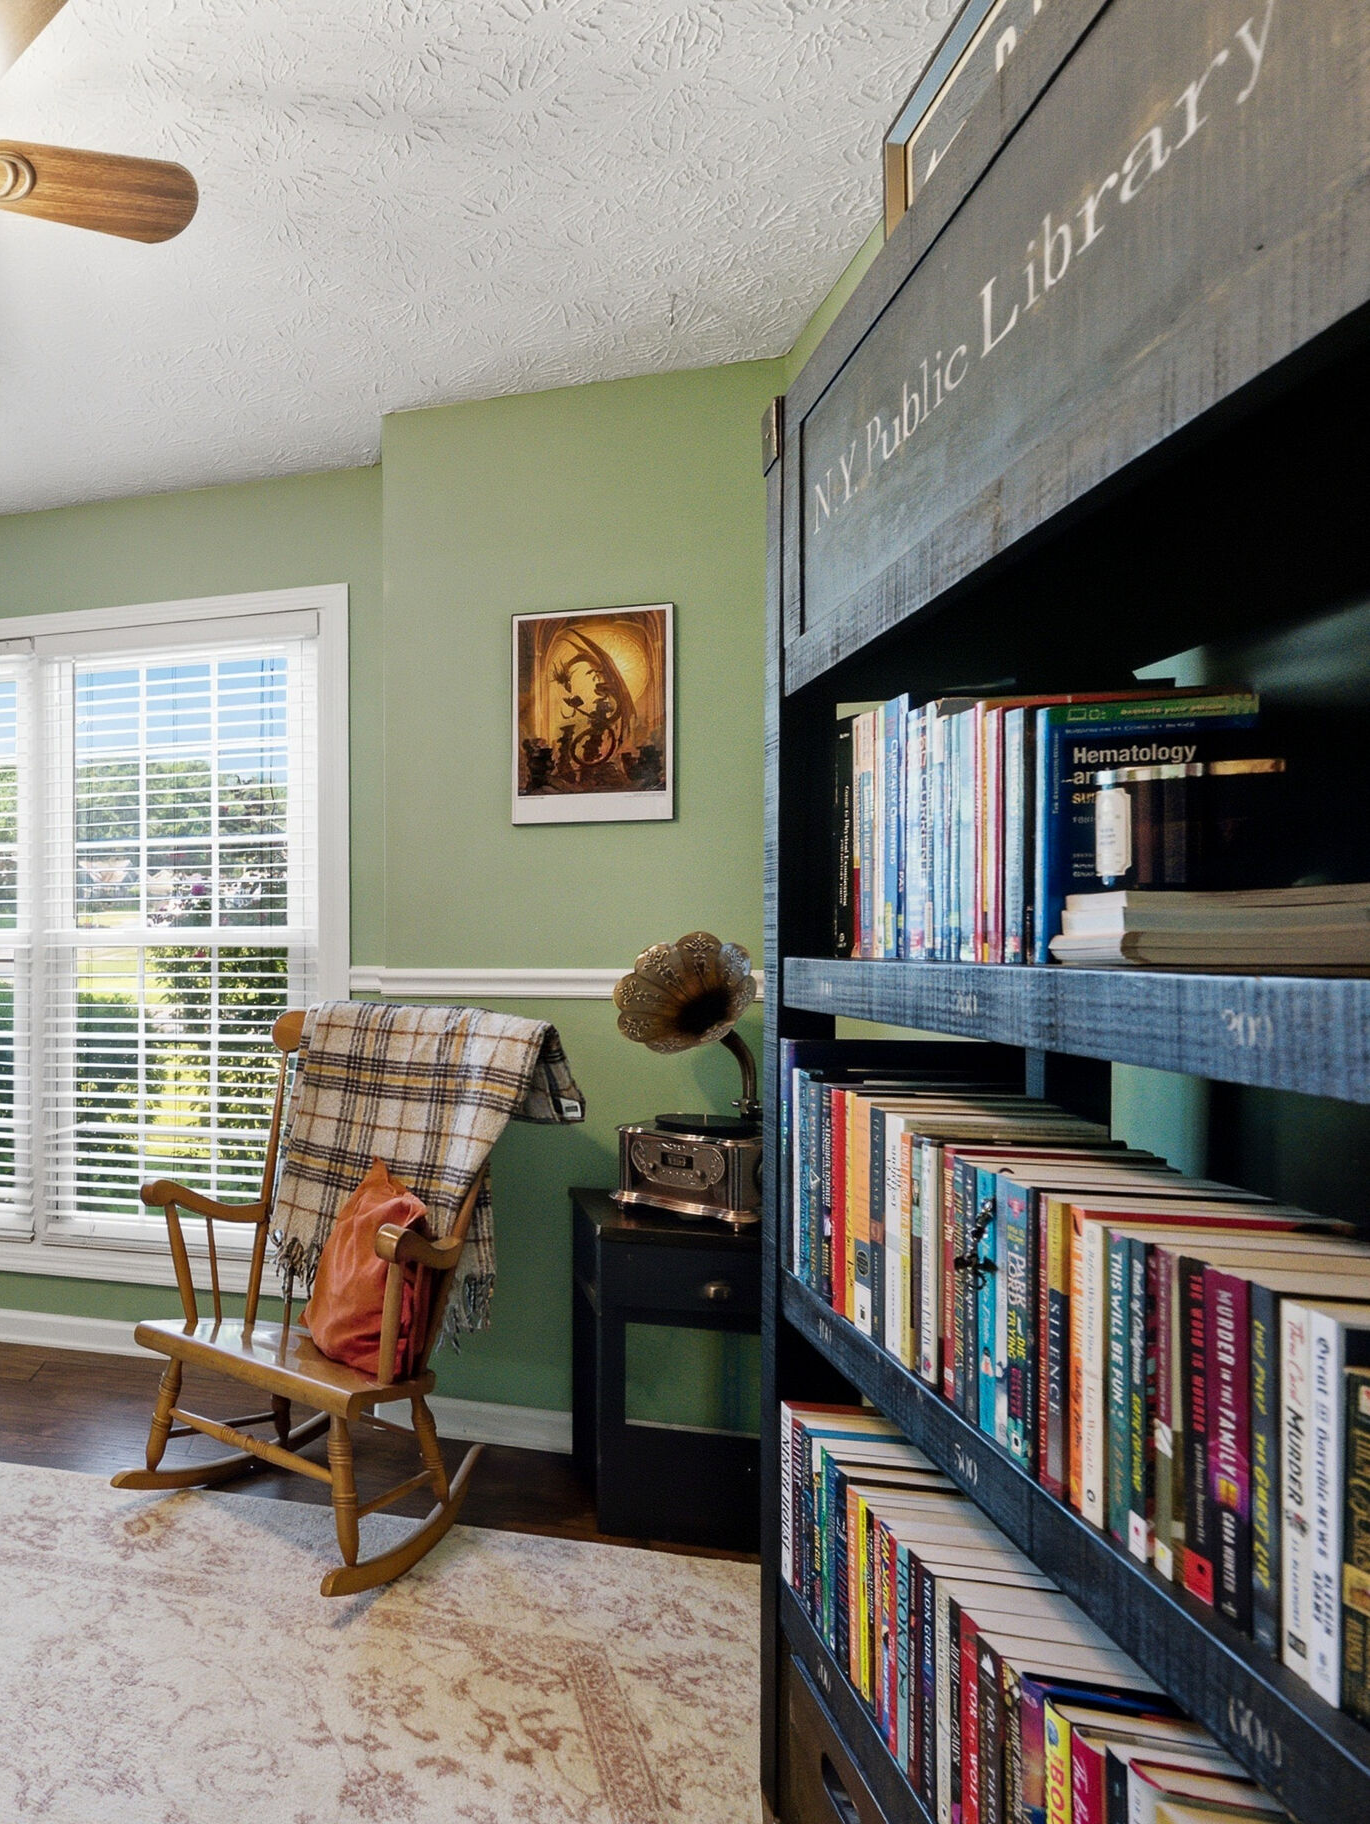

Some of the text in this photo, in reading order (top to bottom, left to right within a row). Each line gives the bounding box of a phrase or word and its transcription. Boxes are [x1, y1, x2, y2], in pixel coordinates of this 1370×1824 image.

[812, 440, 859, 536] N.Y.
[865, 343, 970, 476] Public
[979, 0, 1277, 358] Library
[1073, 743, 1197, 764] Hematology
[1007, 1308, 1015, 1359] TRYING
[1049, 1300, 1060, 1416] SILENCE
[1111, 1248, 1123, 1405] THIS WILL BE FUN
[1130, 1258, 1143, 1388] Birds of California
[1188, 1273, 1205, 1435] THE WORD IS MURDER
[1214, 1287, 1237, 1478] MURDER IN THE FAMILY
[1315, 1334, 1330, 1399] Great
[1286, 1318, 1305, 1509] Three Card MURDER
[1253, 1463, 1269, 1544] GUEST
[1316, 1503, 1328, 1560] NEWS
[1221, 1507, 1235, 1597] CARA HUNTER
[1253, 1539, 1270, 1591] LIST
[923, 1574, 931, 1668] NEON GODS
[1312, 1569, 1322, 1624] ADAMS
[968, 1678, 977, 1720] FOR
[986, 1694, 995, 1735] FOR
[969, 1748, 977, 1809] WOLF
